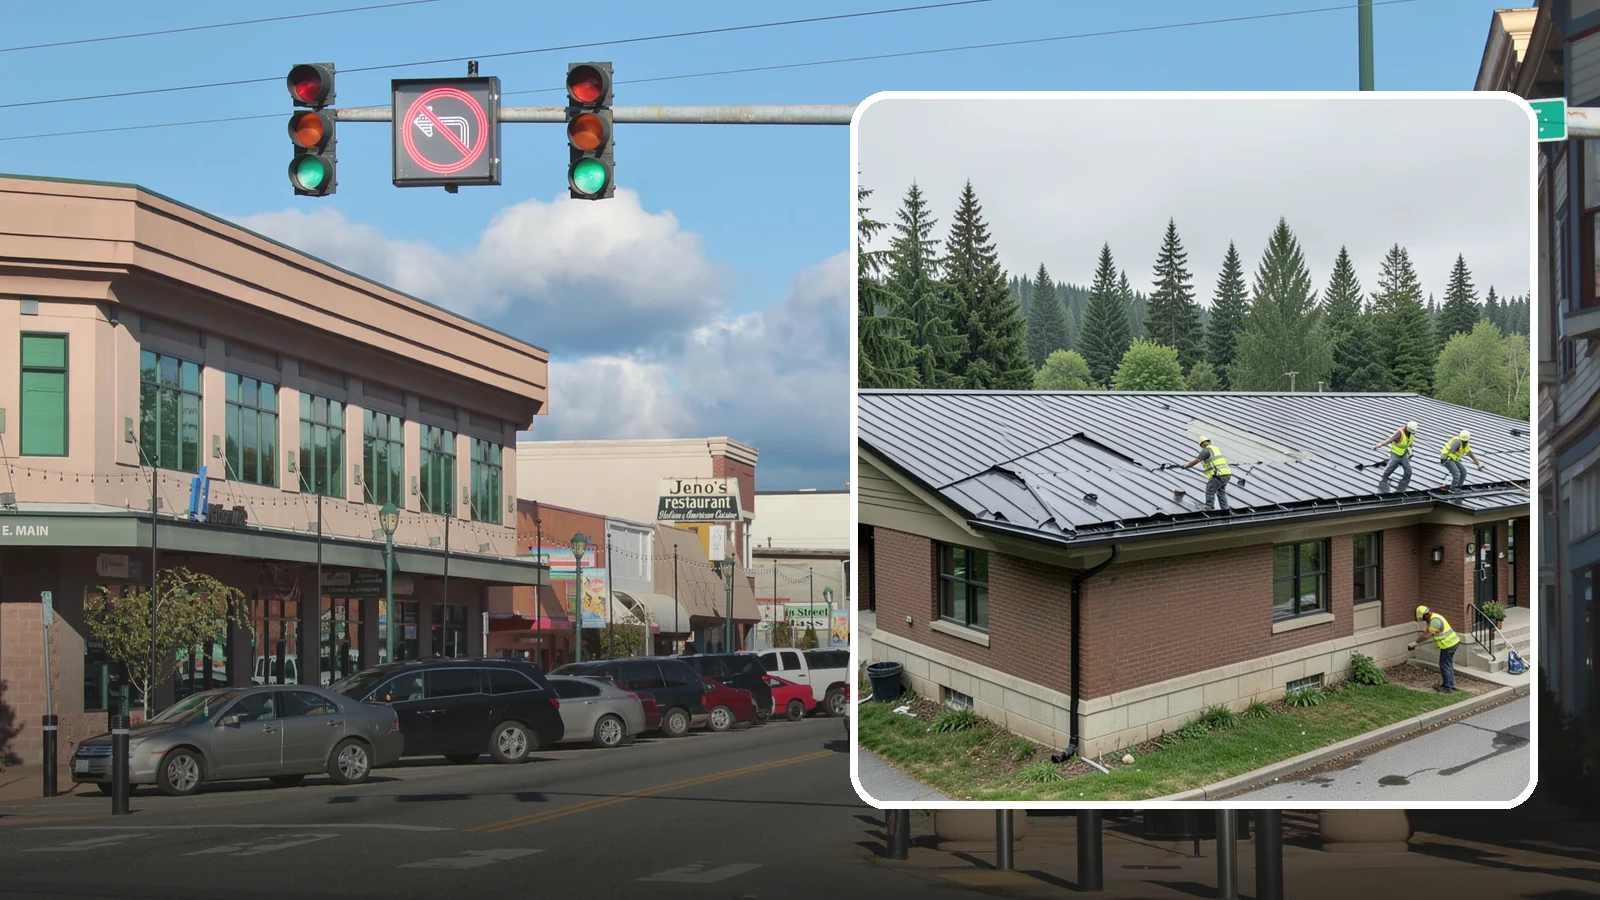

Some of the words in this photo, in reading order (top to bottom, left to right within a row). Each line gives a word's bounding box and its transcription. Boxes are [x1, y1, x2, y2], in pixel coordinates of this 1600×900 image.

[669, 480, 727, 495] Jeno's
[665, 496, 731, 509] restaurant
[658, 509, 682, 520] Italian
[686, 509, 714, 519] American
[715, 509, 738, 519] Cuisine
[2, 525, 13, 536] E.
[15, 525, 49, 536] MAIN
[797, 608, 828, 616] Street
[791, 619, 823, 627] lass
